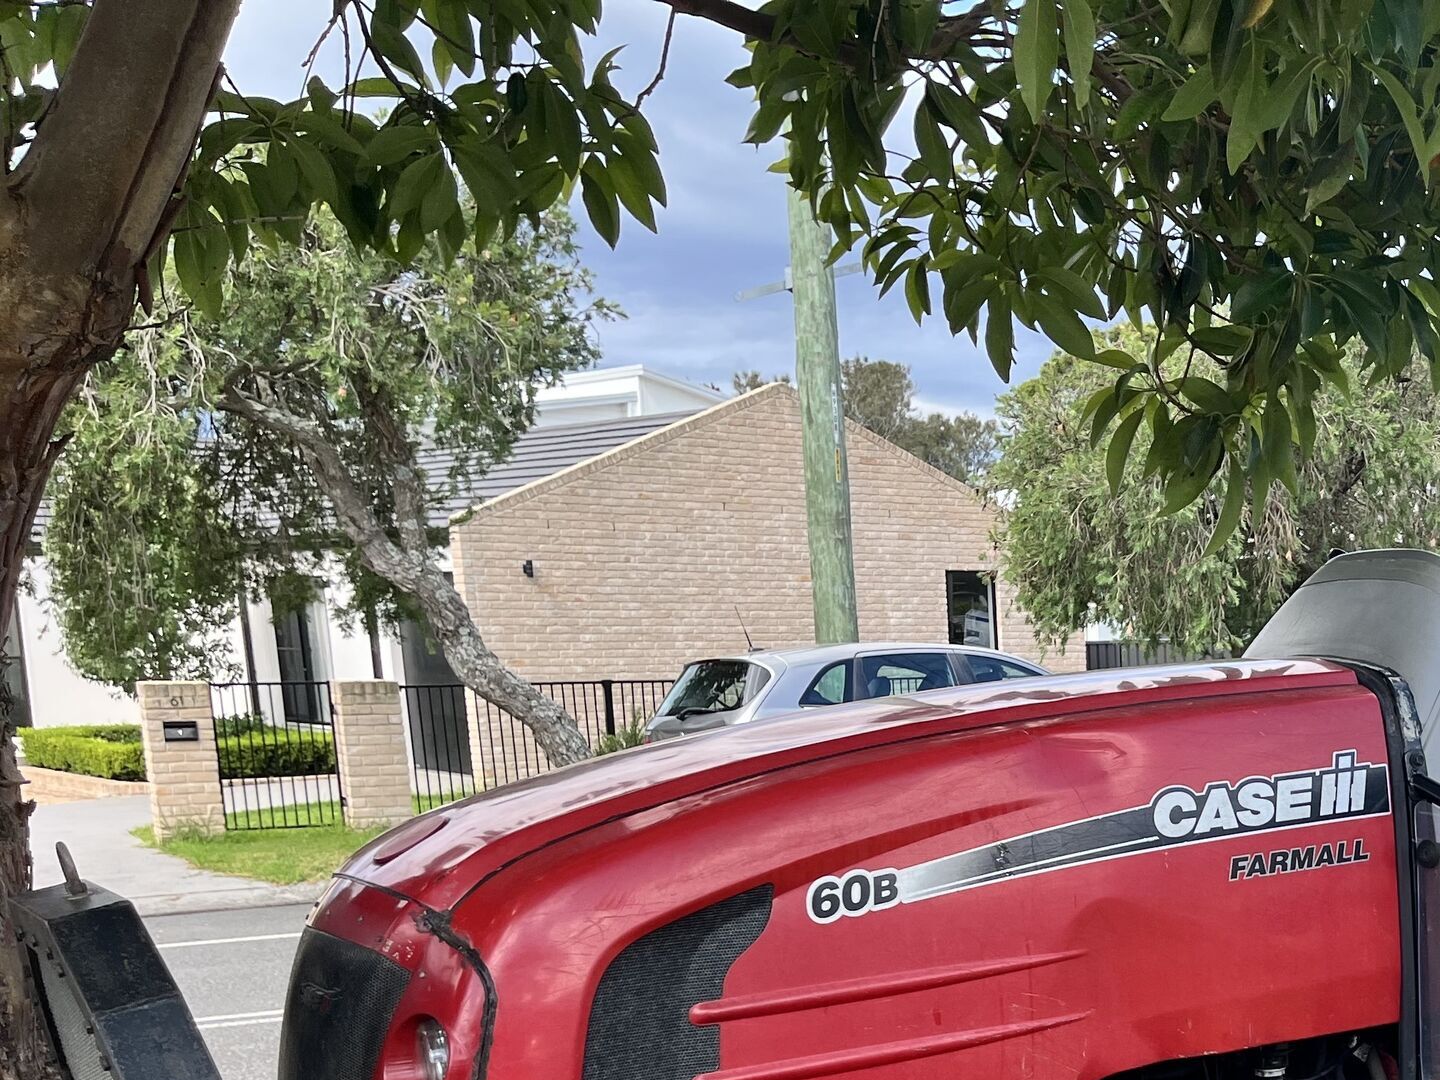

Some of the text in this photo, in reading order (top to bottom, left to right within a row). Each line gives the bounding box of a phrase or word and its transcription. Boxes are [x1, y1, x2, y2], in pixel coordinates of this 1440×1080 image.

[1153, 776, 1313, 839] CASE
[1229, 840, 1369, 881] FARMALL
[811, 873, 899, 919] 60B
